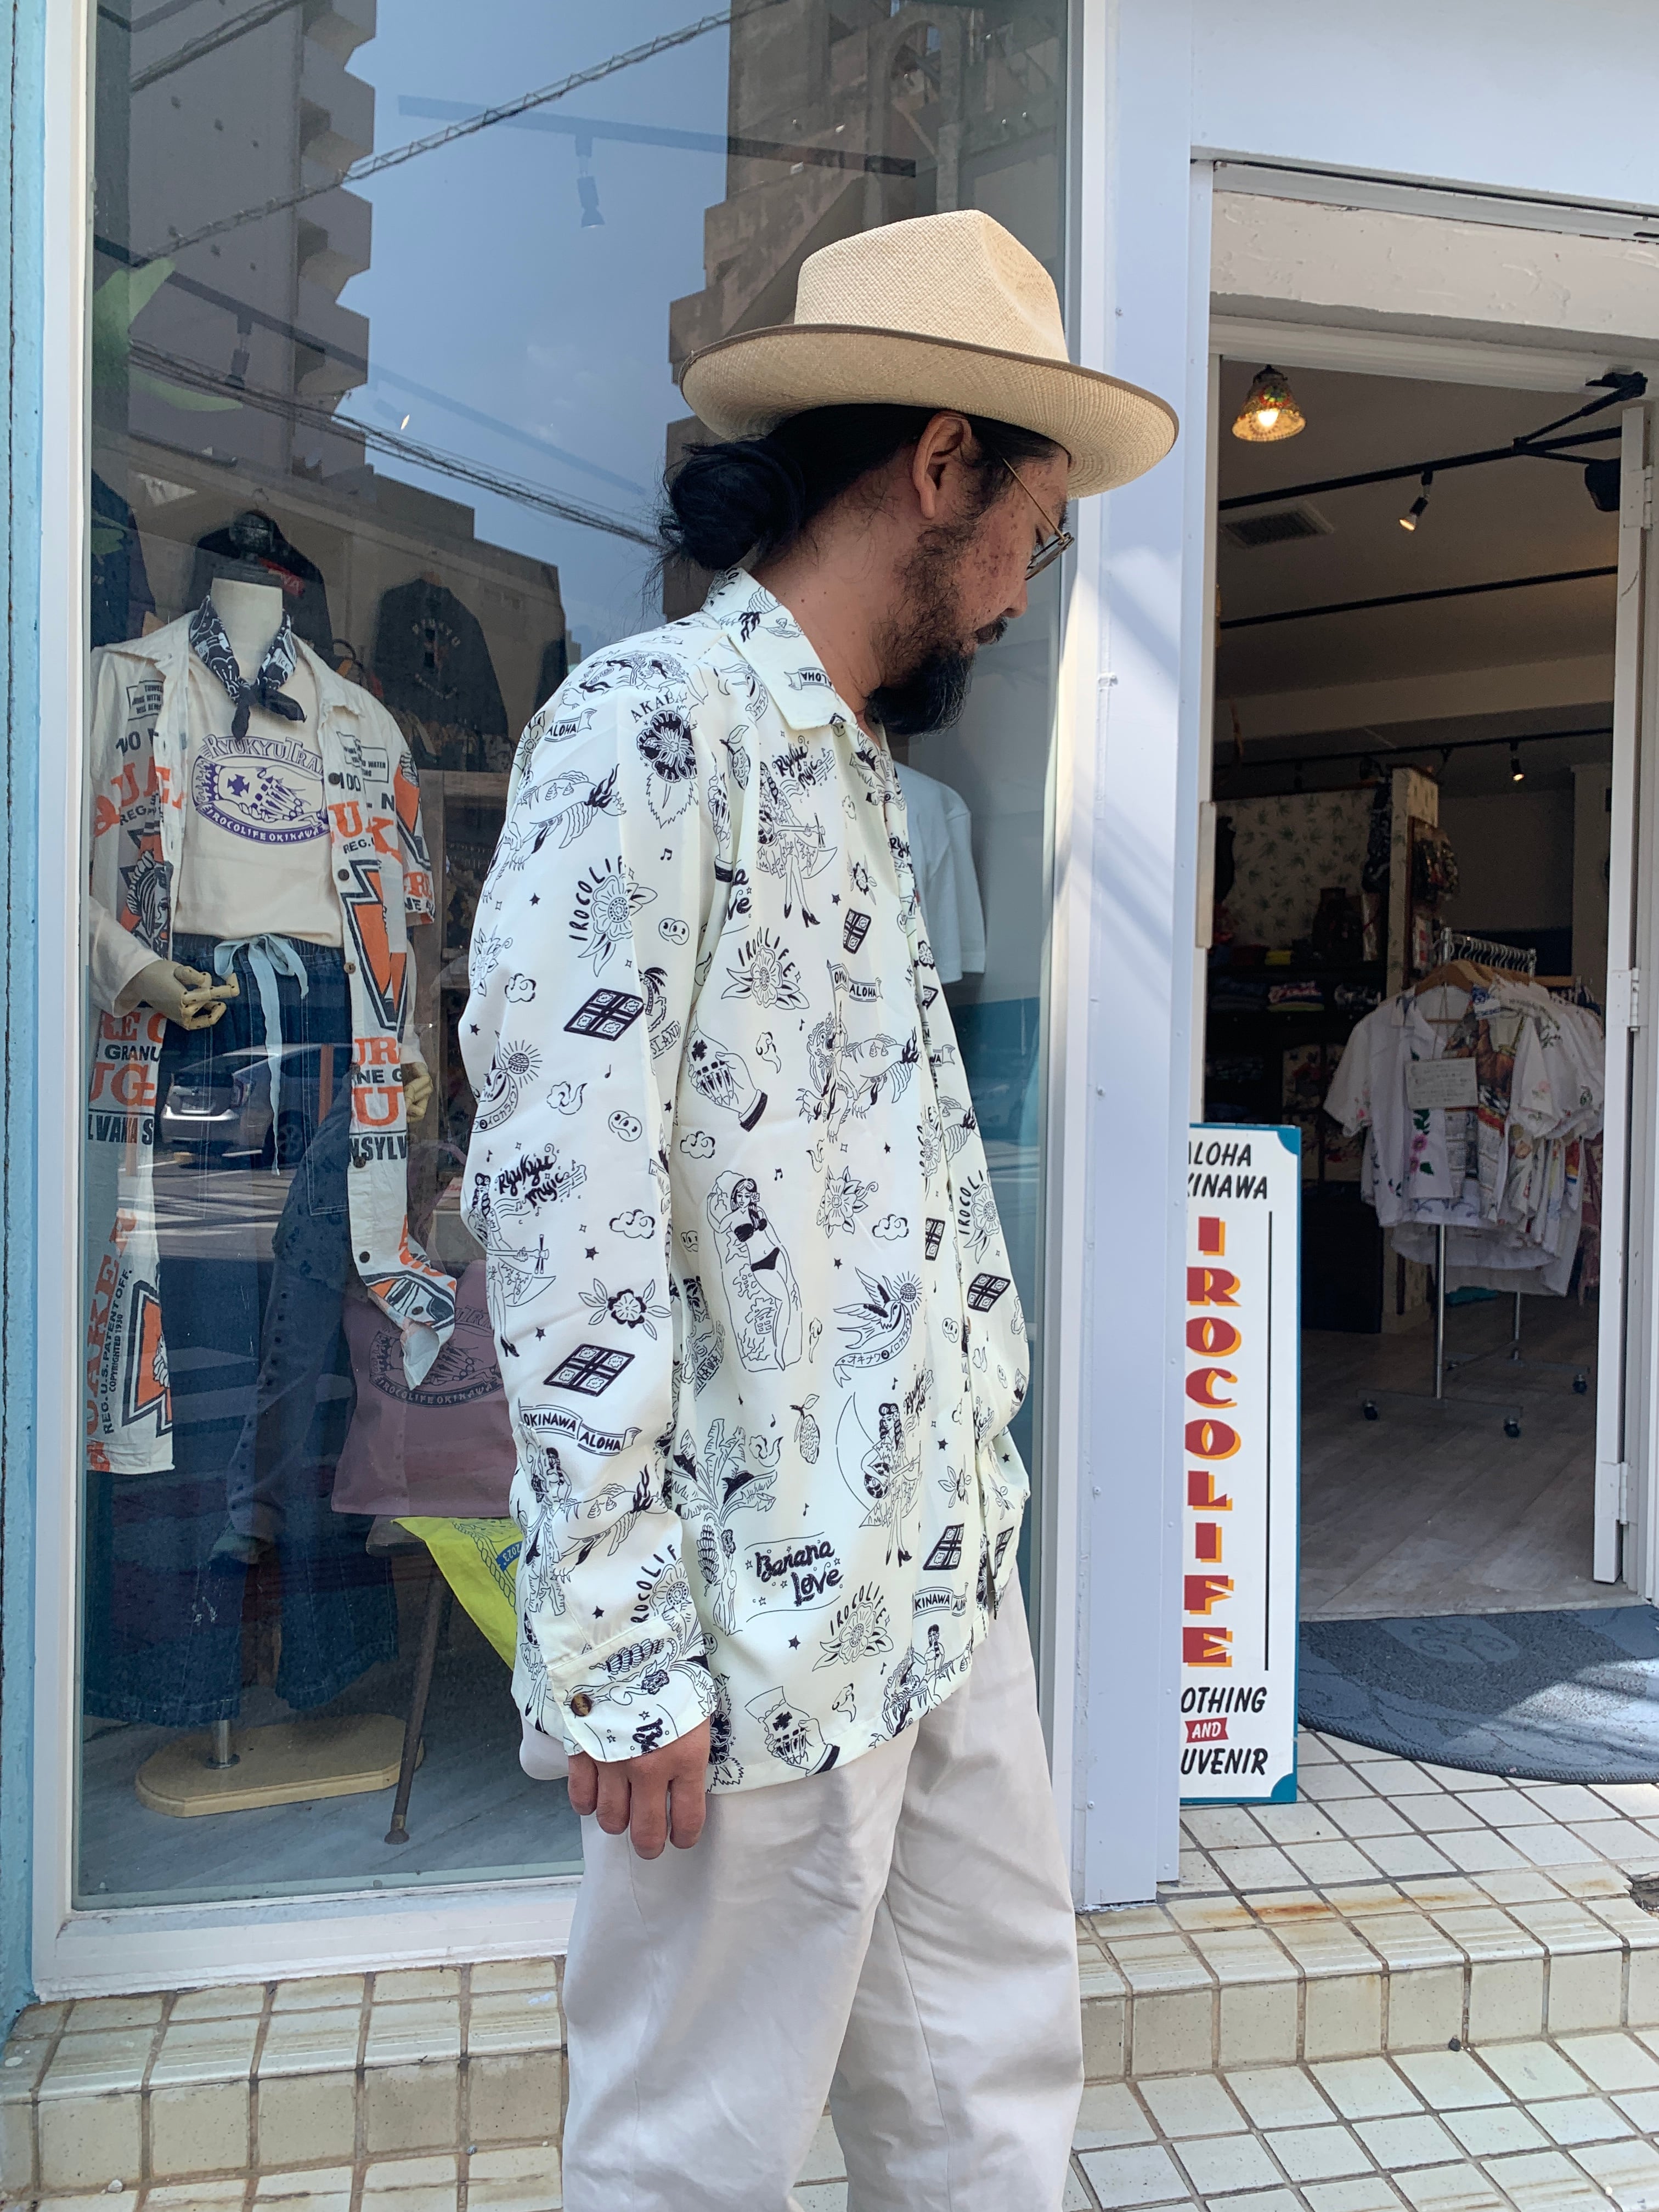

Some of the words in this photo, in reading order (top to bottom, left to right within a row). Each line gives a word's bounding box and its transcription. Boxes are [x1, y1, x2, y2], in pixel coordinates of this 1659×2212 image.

[546, 723, 577, 737] ALOHA
[202, 734, 286, 760] RYUKYU
[206, 805, 266, 841] IROCOLIFE
[269, 829, 319, 842] OKINAWA
[114, 1314, 124, 1333] 1930
[523, 1412, 576, 1432] OKINAWA
[579, 1431, 621, 1451] ALOHA
[755, 1541, 835, 1583] Banana
[790, 1562, 844, 1607] Love
[1181, 1686, 1267, 1713] OTHING
[1192, 1721, 1221, 1739] AND
[1181, 1748, 1268, 1775] UVENIR
